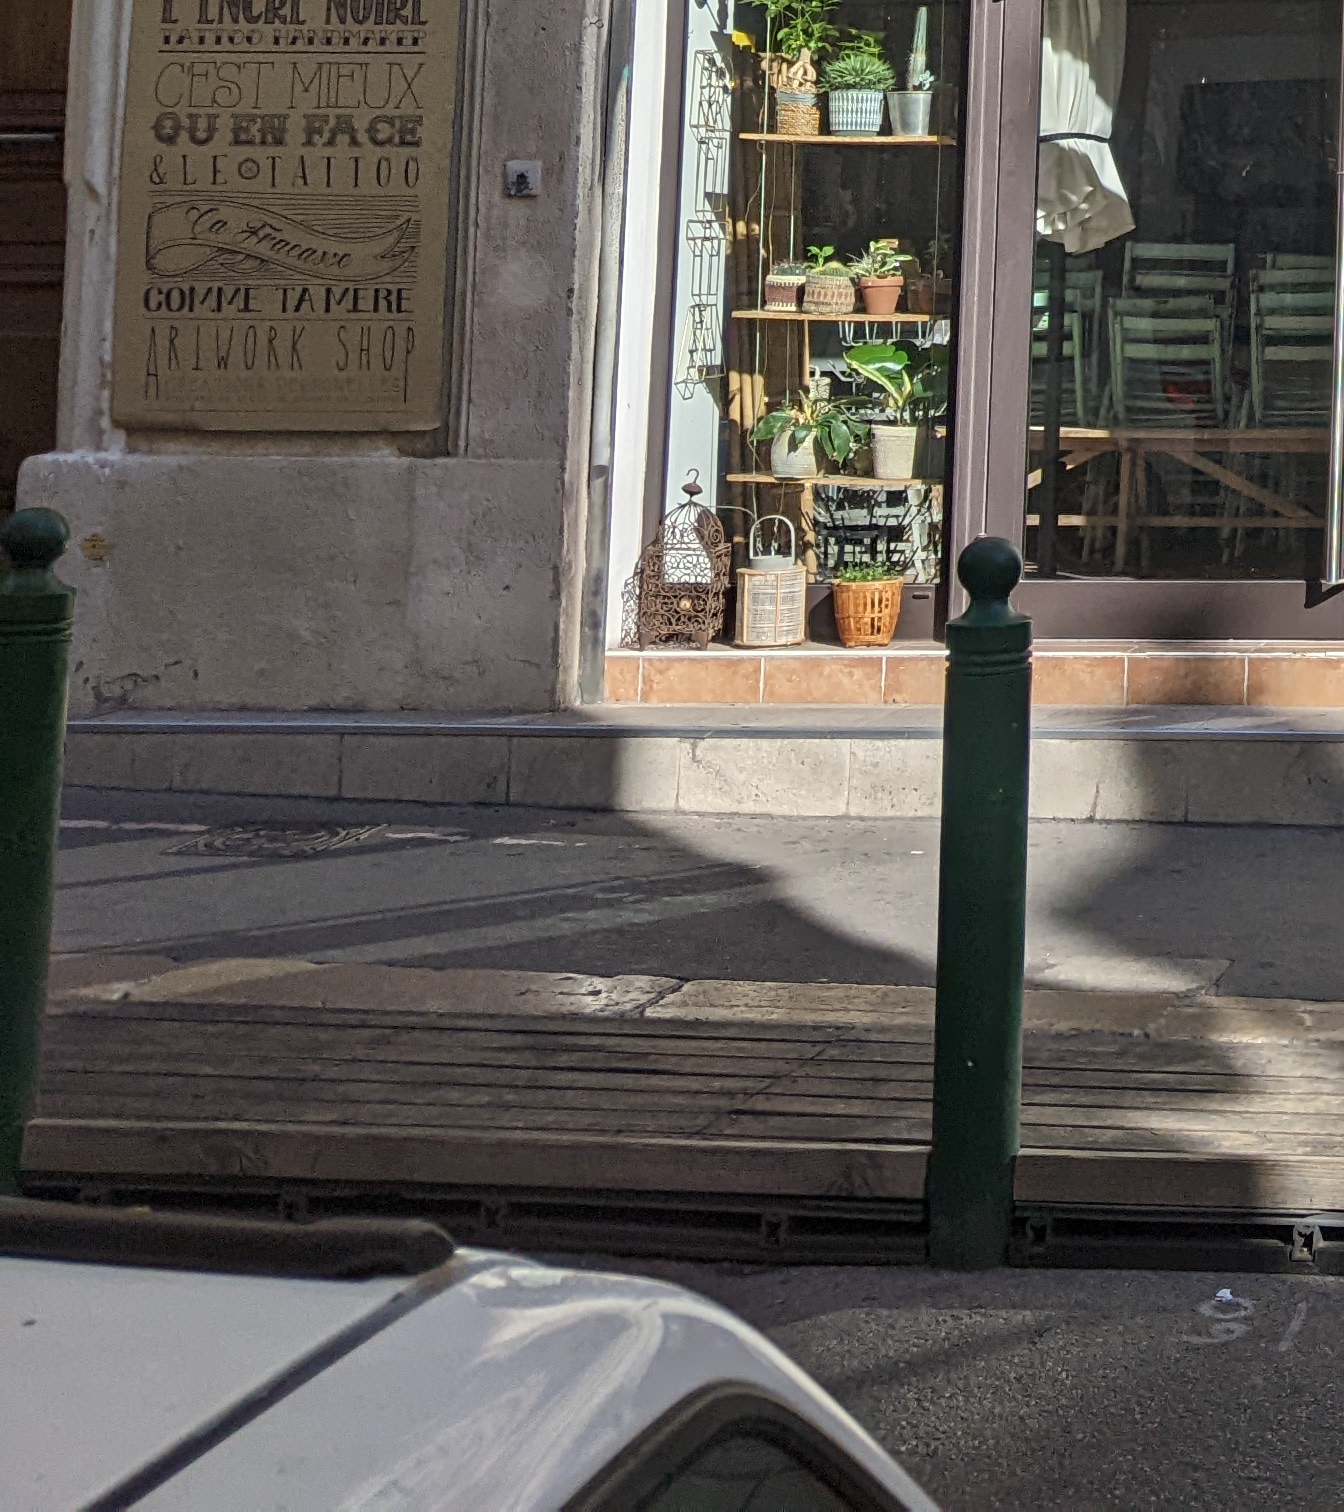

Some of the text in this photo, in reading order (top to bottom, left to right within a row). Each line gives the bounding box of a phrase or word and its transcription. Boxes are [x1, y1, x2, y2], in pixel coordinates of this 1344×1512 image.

[288, 62, 427, 110] MIEUX
[301, 113, 425, 148] FACE
[149, 154, 167, 186] &
[266, 155, 420, 188] TATTOO
[143, 287, 262, 314] COMME
[275, 287, 315, 314] TA
[335, 325, 416, 404] SHOP
